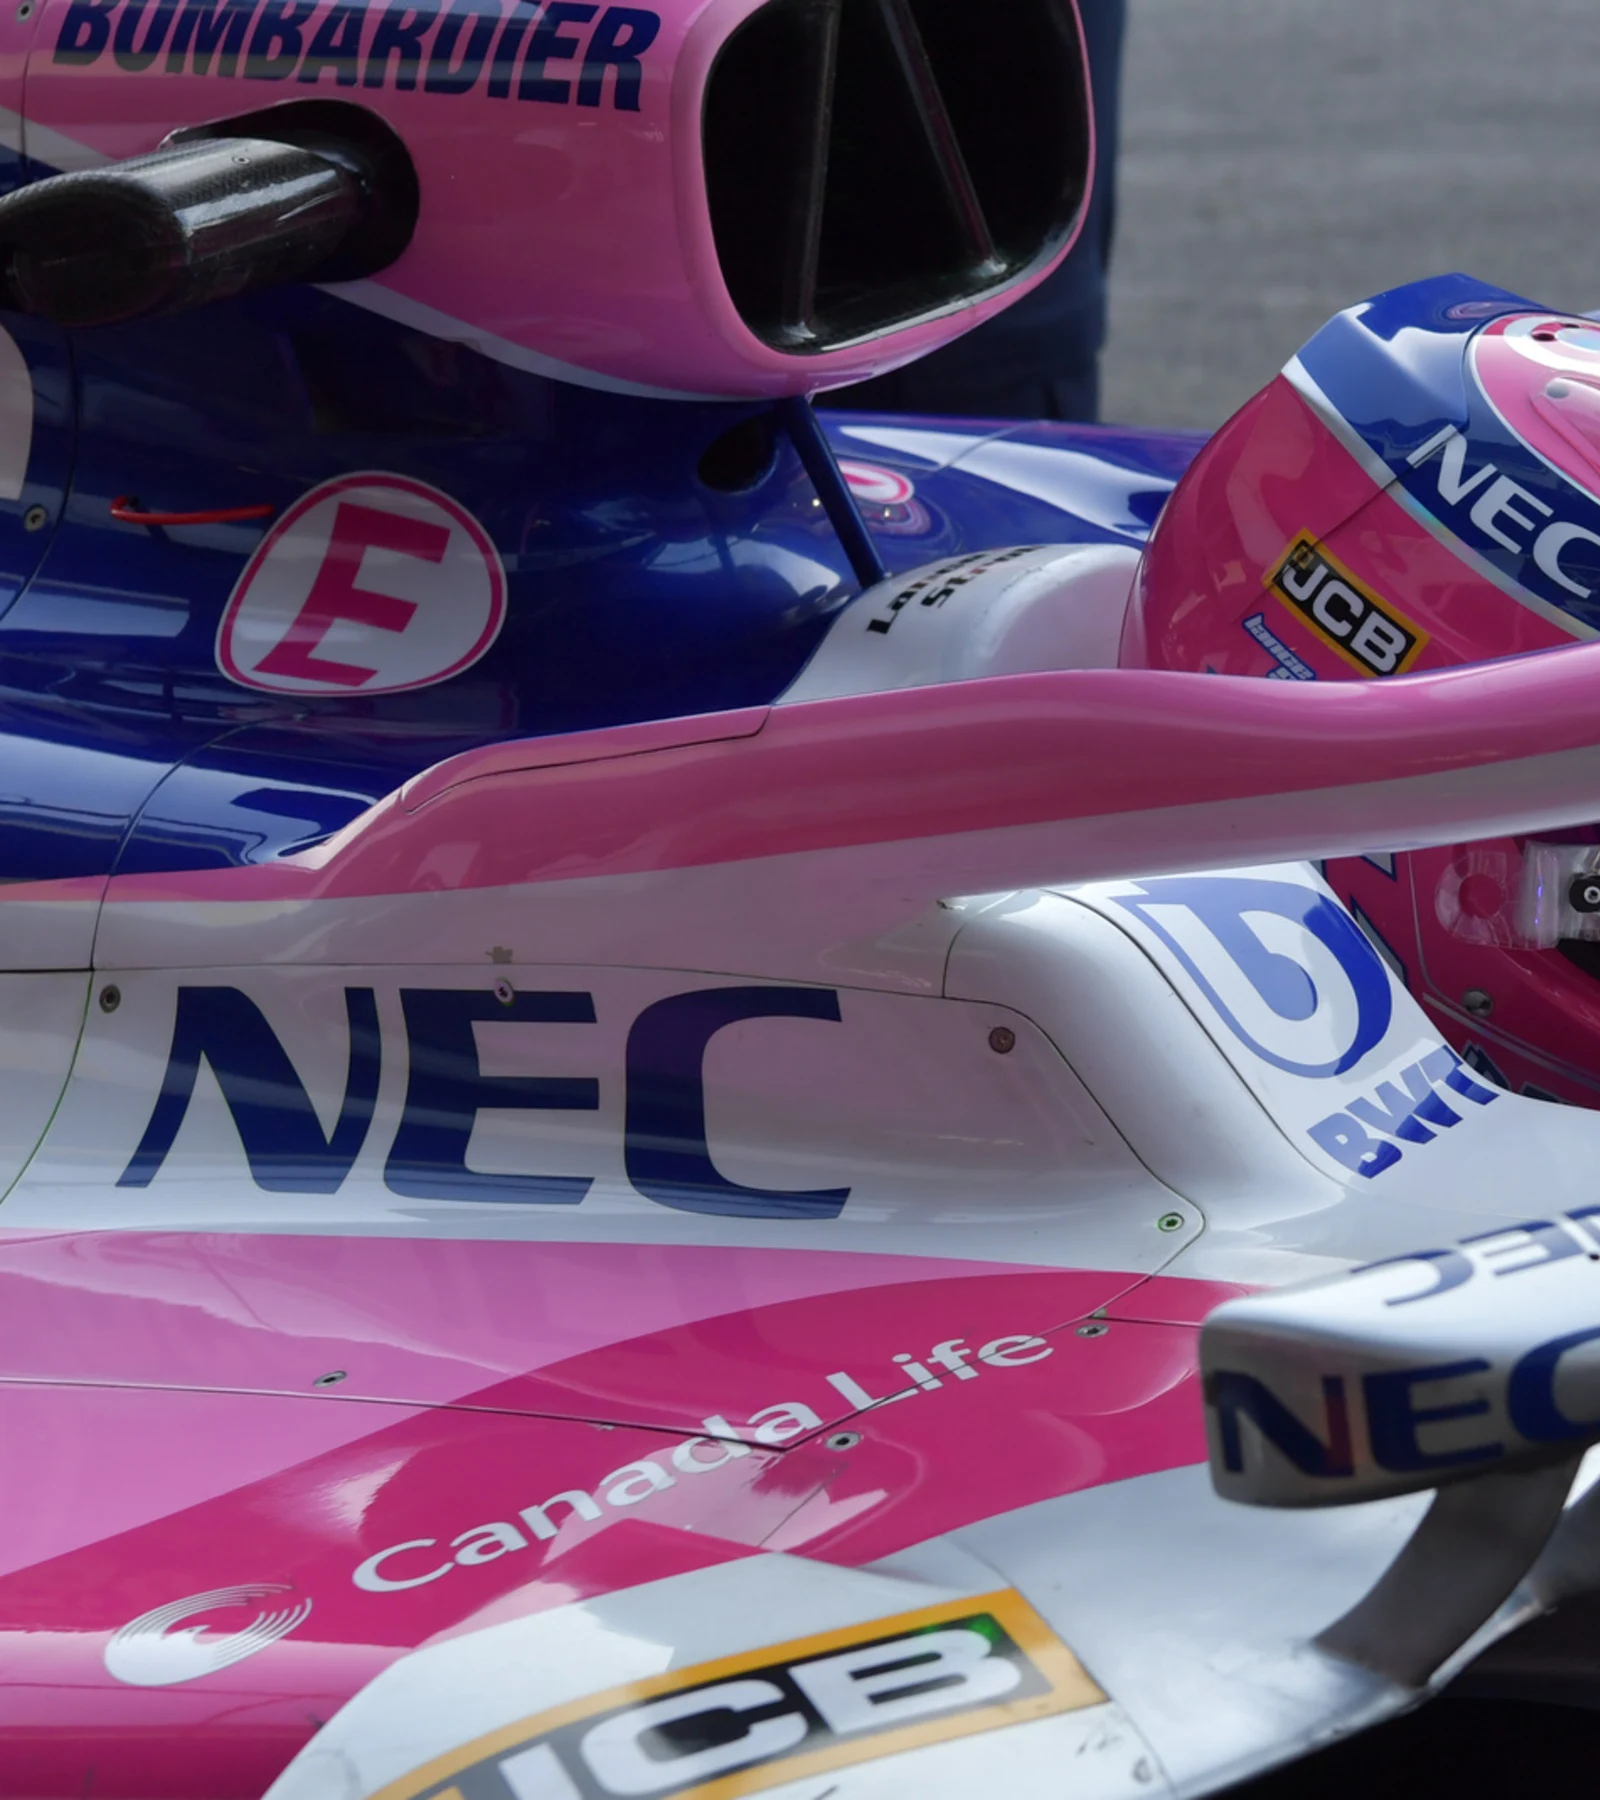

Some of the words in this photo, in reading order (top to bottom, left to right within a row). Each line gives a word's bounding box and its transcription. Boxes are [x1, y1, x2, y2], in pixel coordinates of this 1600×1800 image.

[52, 0, 661, 112] BOMBARDIER
[253, 501, 451, 687] E
[1282, 562, 1407, 673] JCB
[114, 985, 852, 1220] NEC
[1306, 1044, 1501, 1180] BWT
[352, 1401, 823, 1593] Canada
[824, 1334, 1055, 1412] Life
